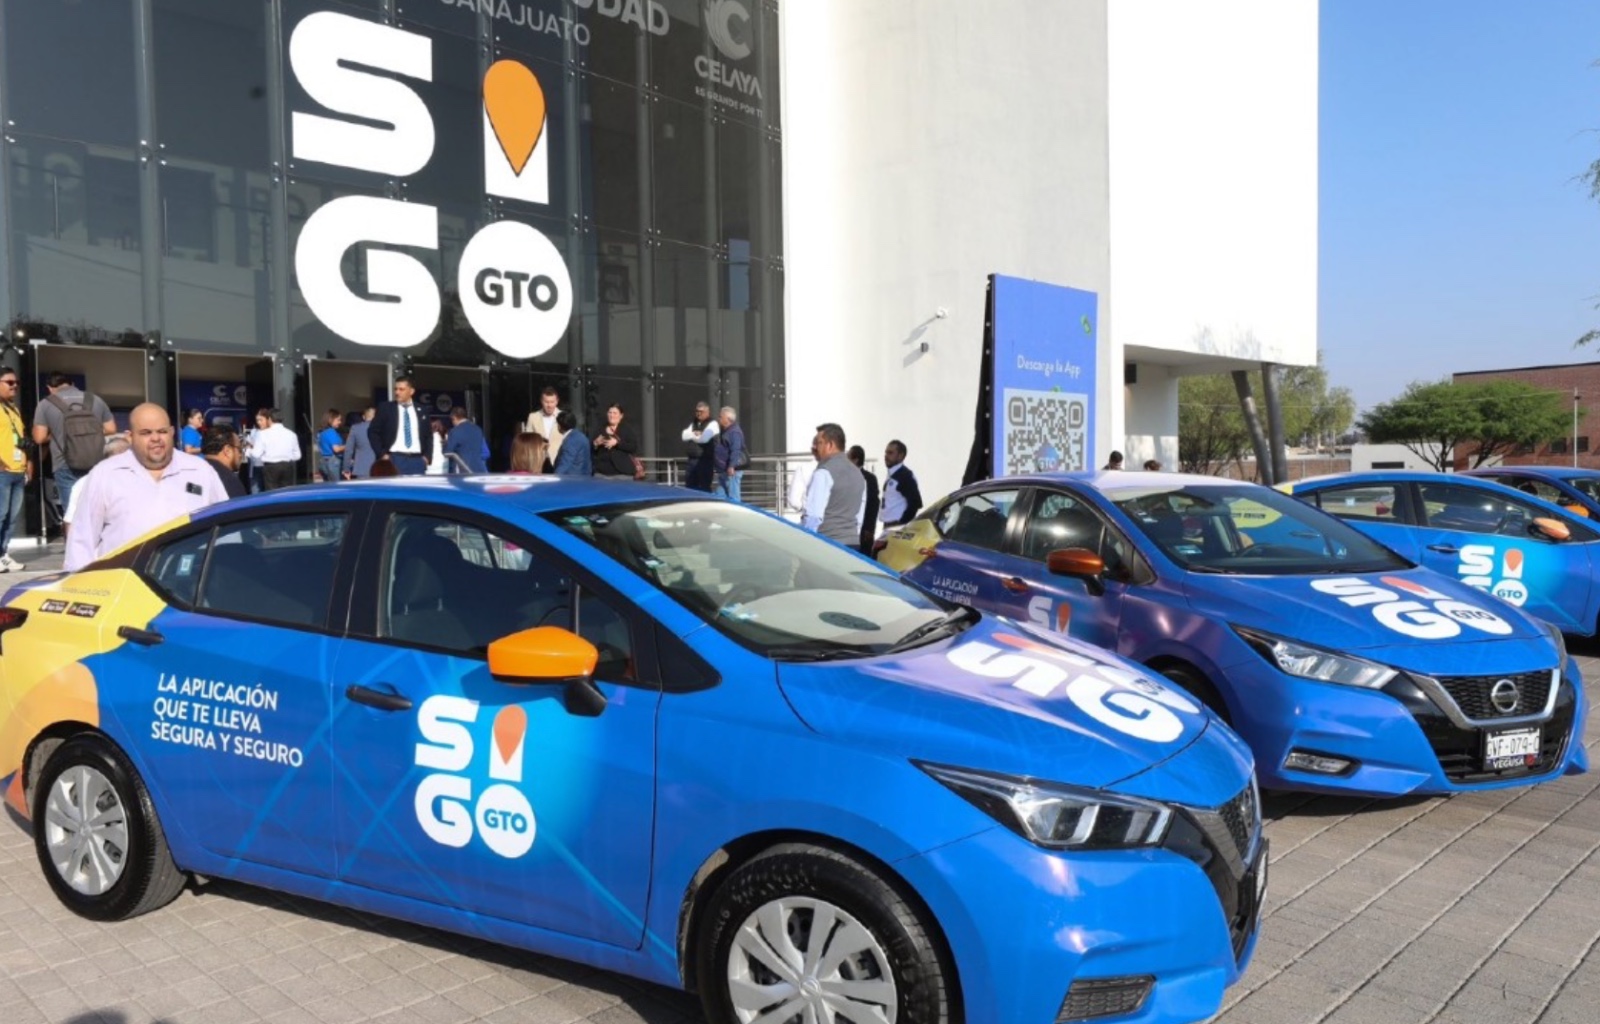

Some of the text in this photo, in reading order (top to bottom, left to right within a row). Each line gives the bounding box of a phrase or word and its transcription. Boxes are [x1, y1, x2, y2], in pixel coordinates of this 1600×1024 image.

[442, 0, 590, 45] ANAJUATO
[573, 0, 670, 36] DAD
[694, 55, 762, 99] CELAYA
[707, 91, 739, 110] GRANDE
[740, 102, 755, 115] POR
[474, 267, 559, 312] GTO
[1064, 360, 1081, 379] App
[1497, 589, 1523, 599] GTO
[1449, 609, 1498, 622] GTO
[157, 673, 278, 711] LA APLICACIÓN
[153, 697, 262, 733] QUE TE LLEVA
[151, 721, 304, 767] SEGURA Y SEGURO
[483, 808, 528, 834] GTO
